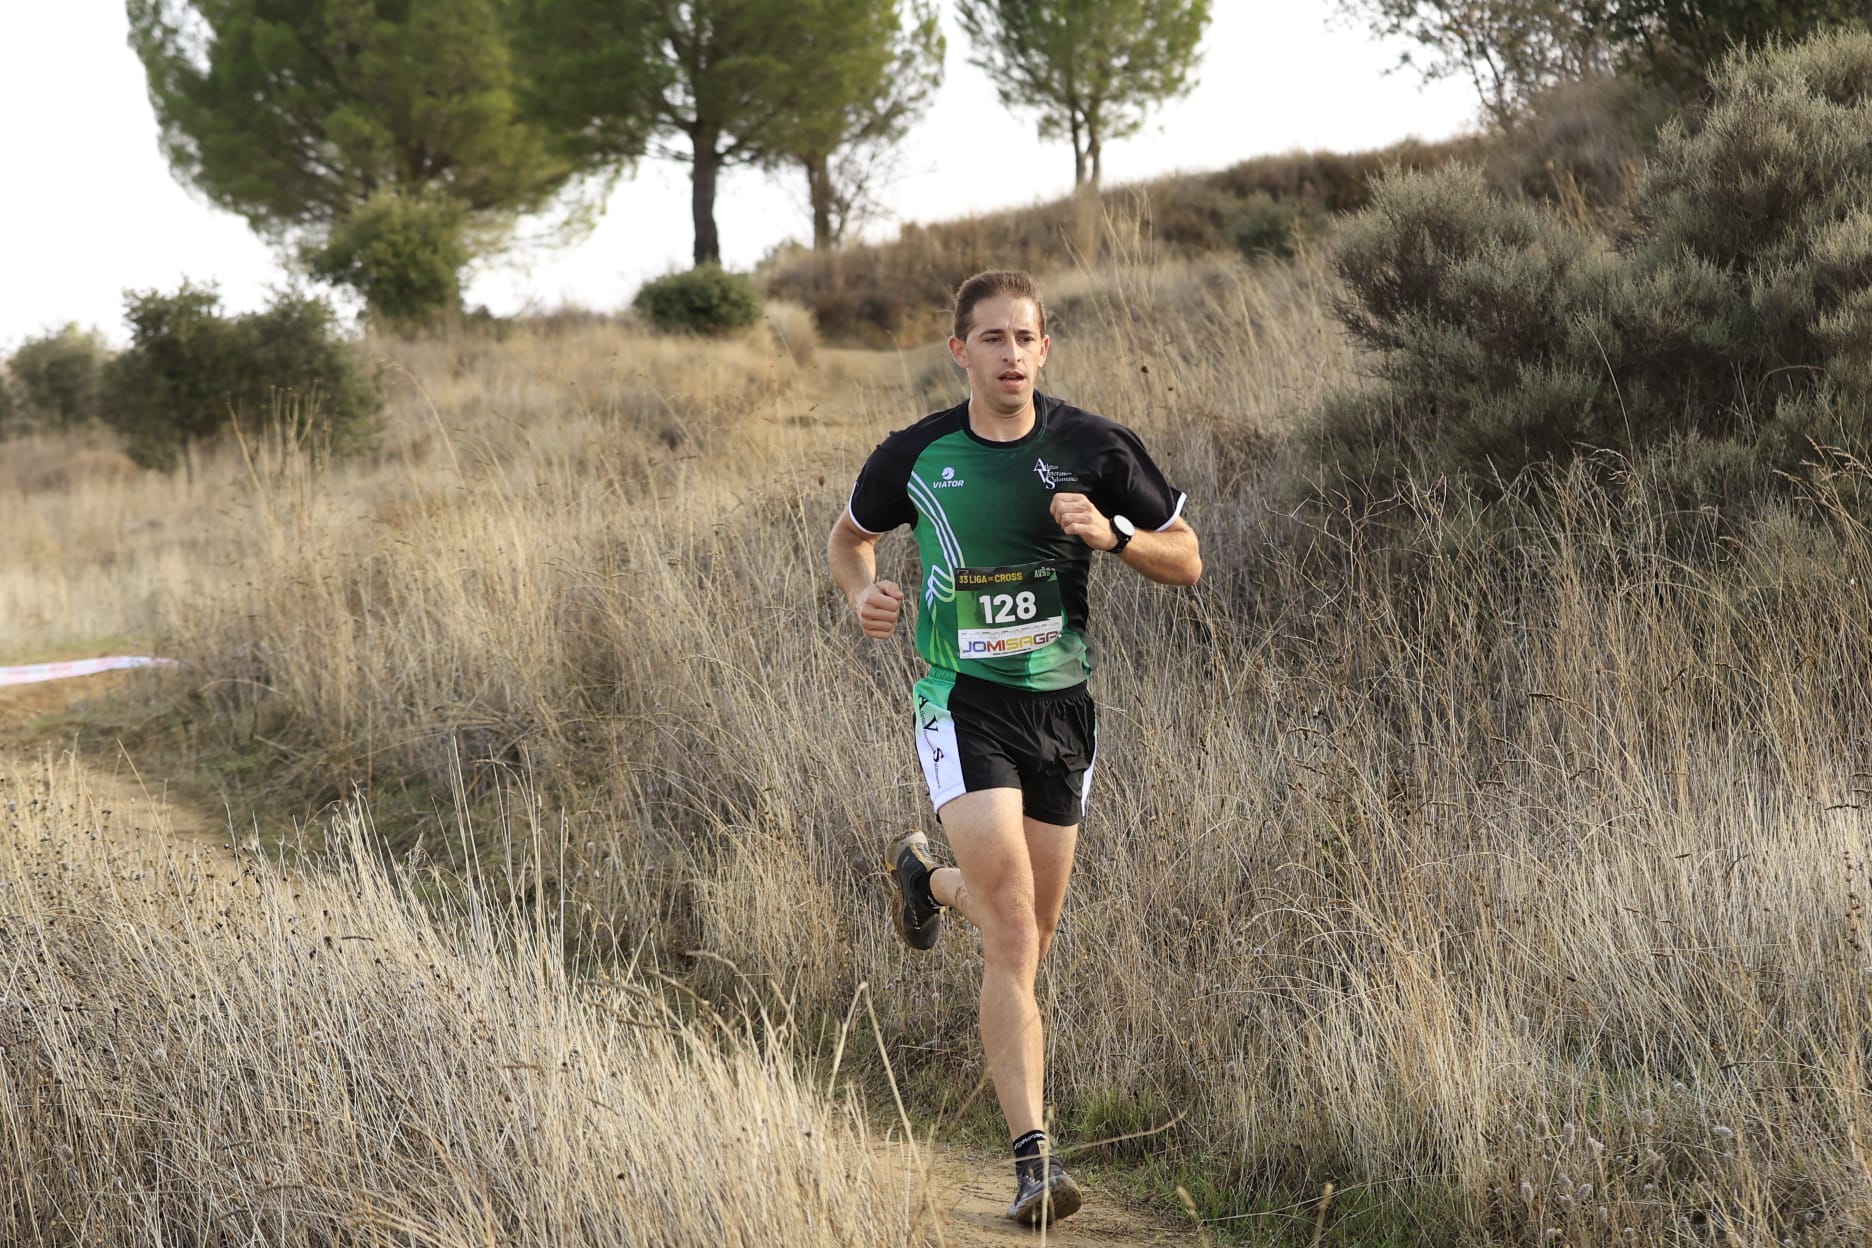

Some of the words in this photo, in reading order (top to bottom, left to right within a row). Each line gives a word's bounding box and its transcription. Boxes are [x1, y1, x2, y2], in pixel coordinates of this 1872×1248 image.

[933, 480, 964, 489] VIATOR
[959, 575, 968, 584] 33
[969, 575, 987, 584] LIGA
[994, 572, 1023, 583] CROSS
[979, 591, 1036, 624] 128
